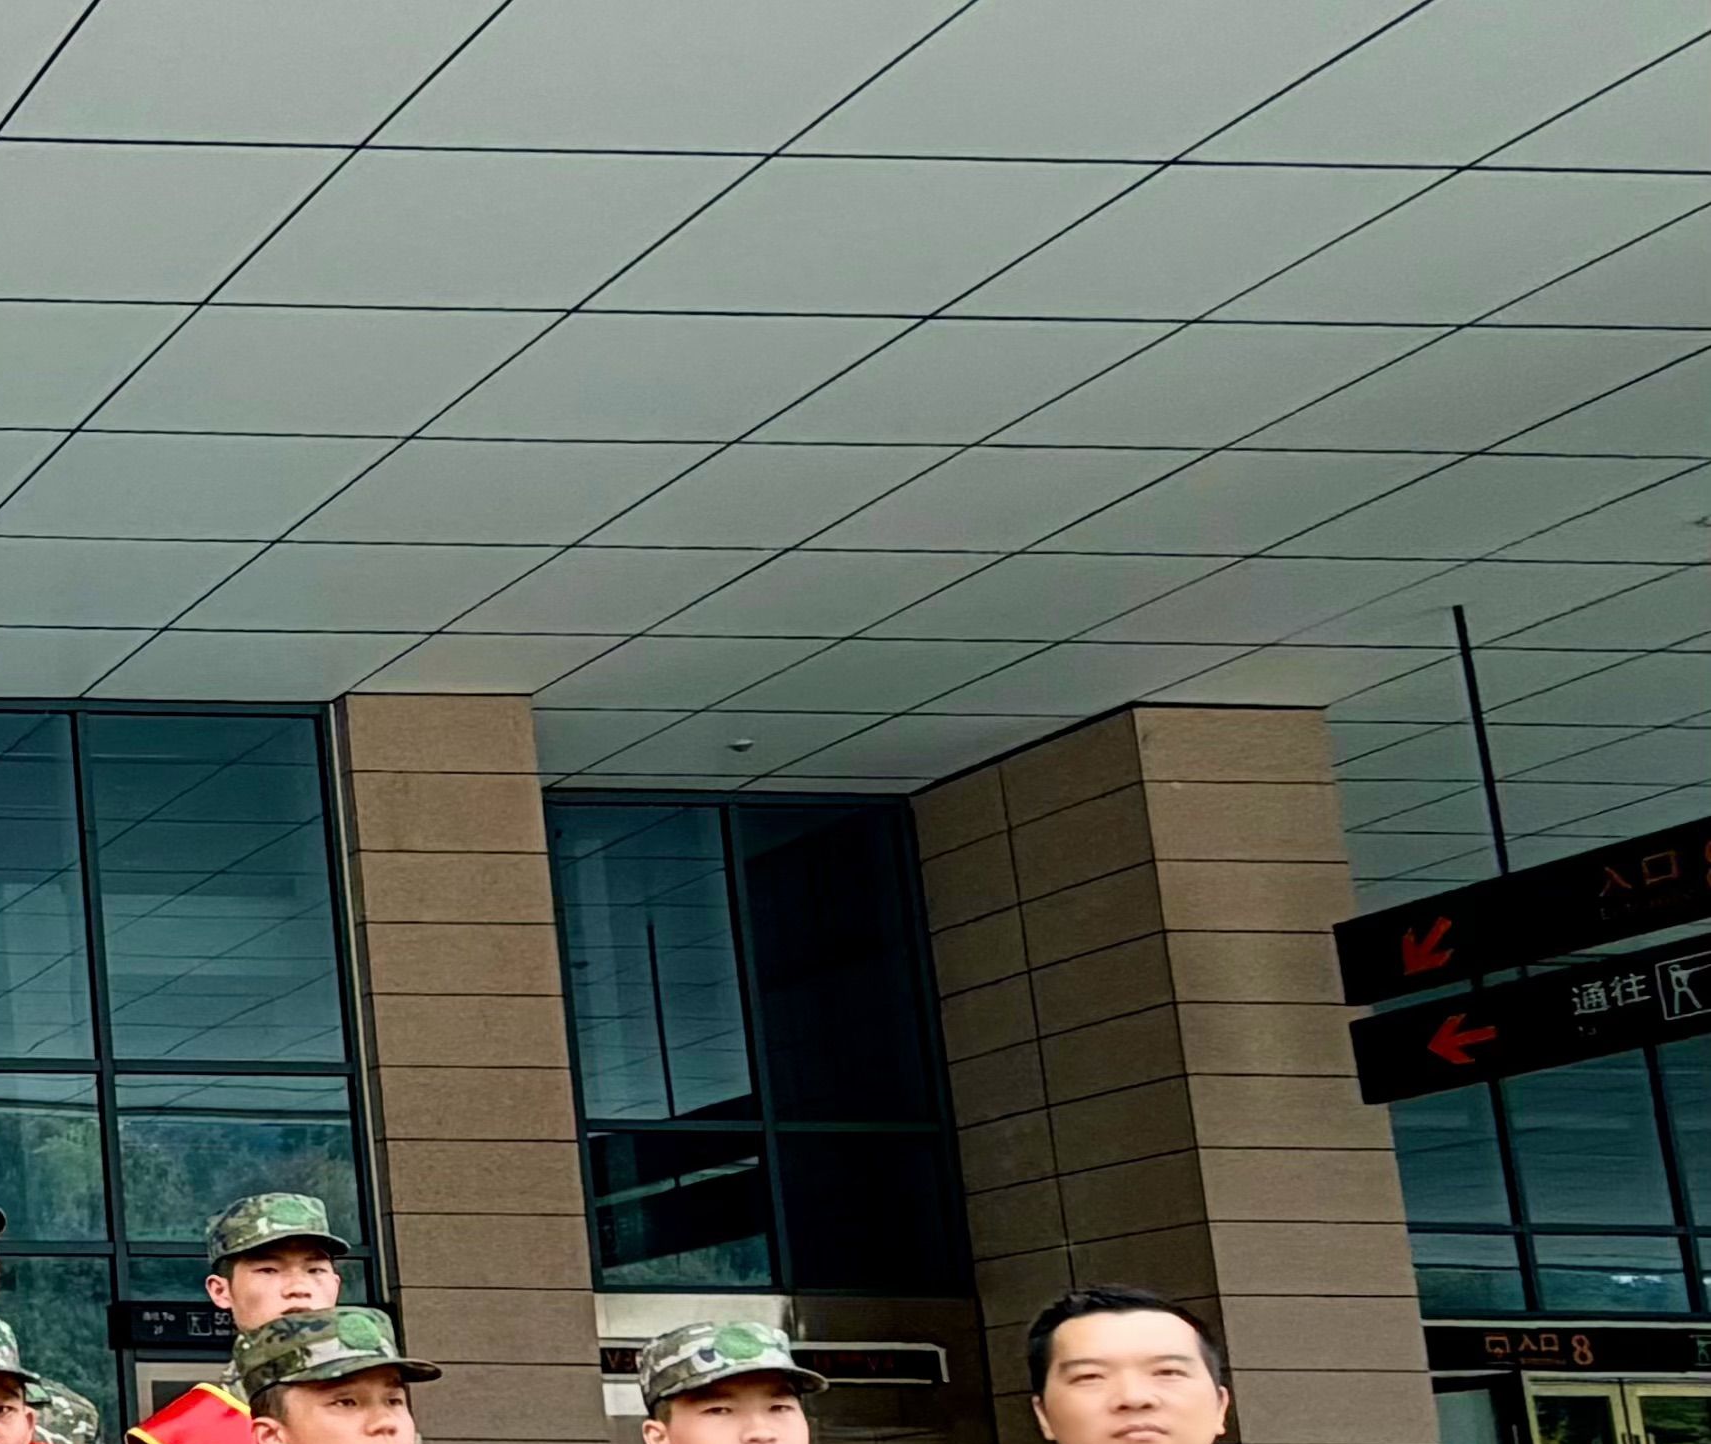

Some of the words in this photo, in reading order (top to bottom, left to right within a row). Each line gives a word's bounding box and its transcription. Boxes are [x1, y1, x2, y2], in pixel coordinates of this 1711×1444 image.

[1599, 851, 1679, 898] 入口
[1571, 973, 1653, 1016] 通往
[1570, 1334, 1594, 1366] 8
